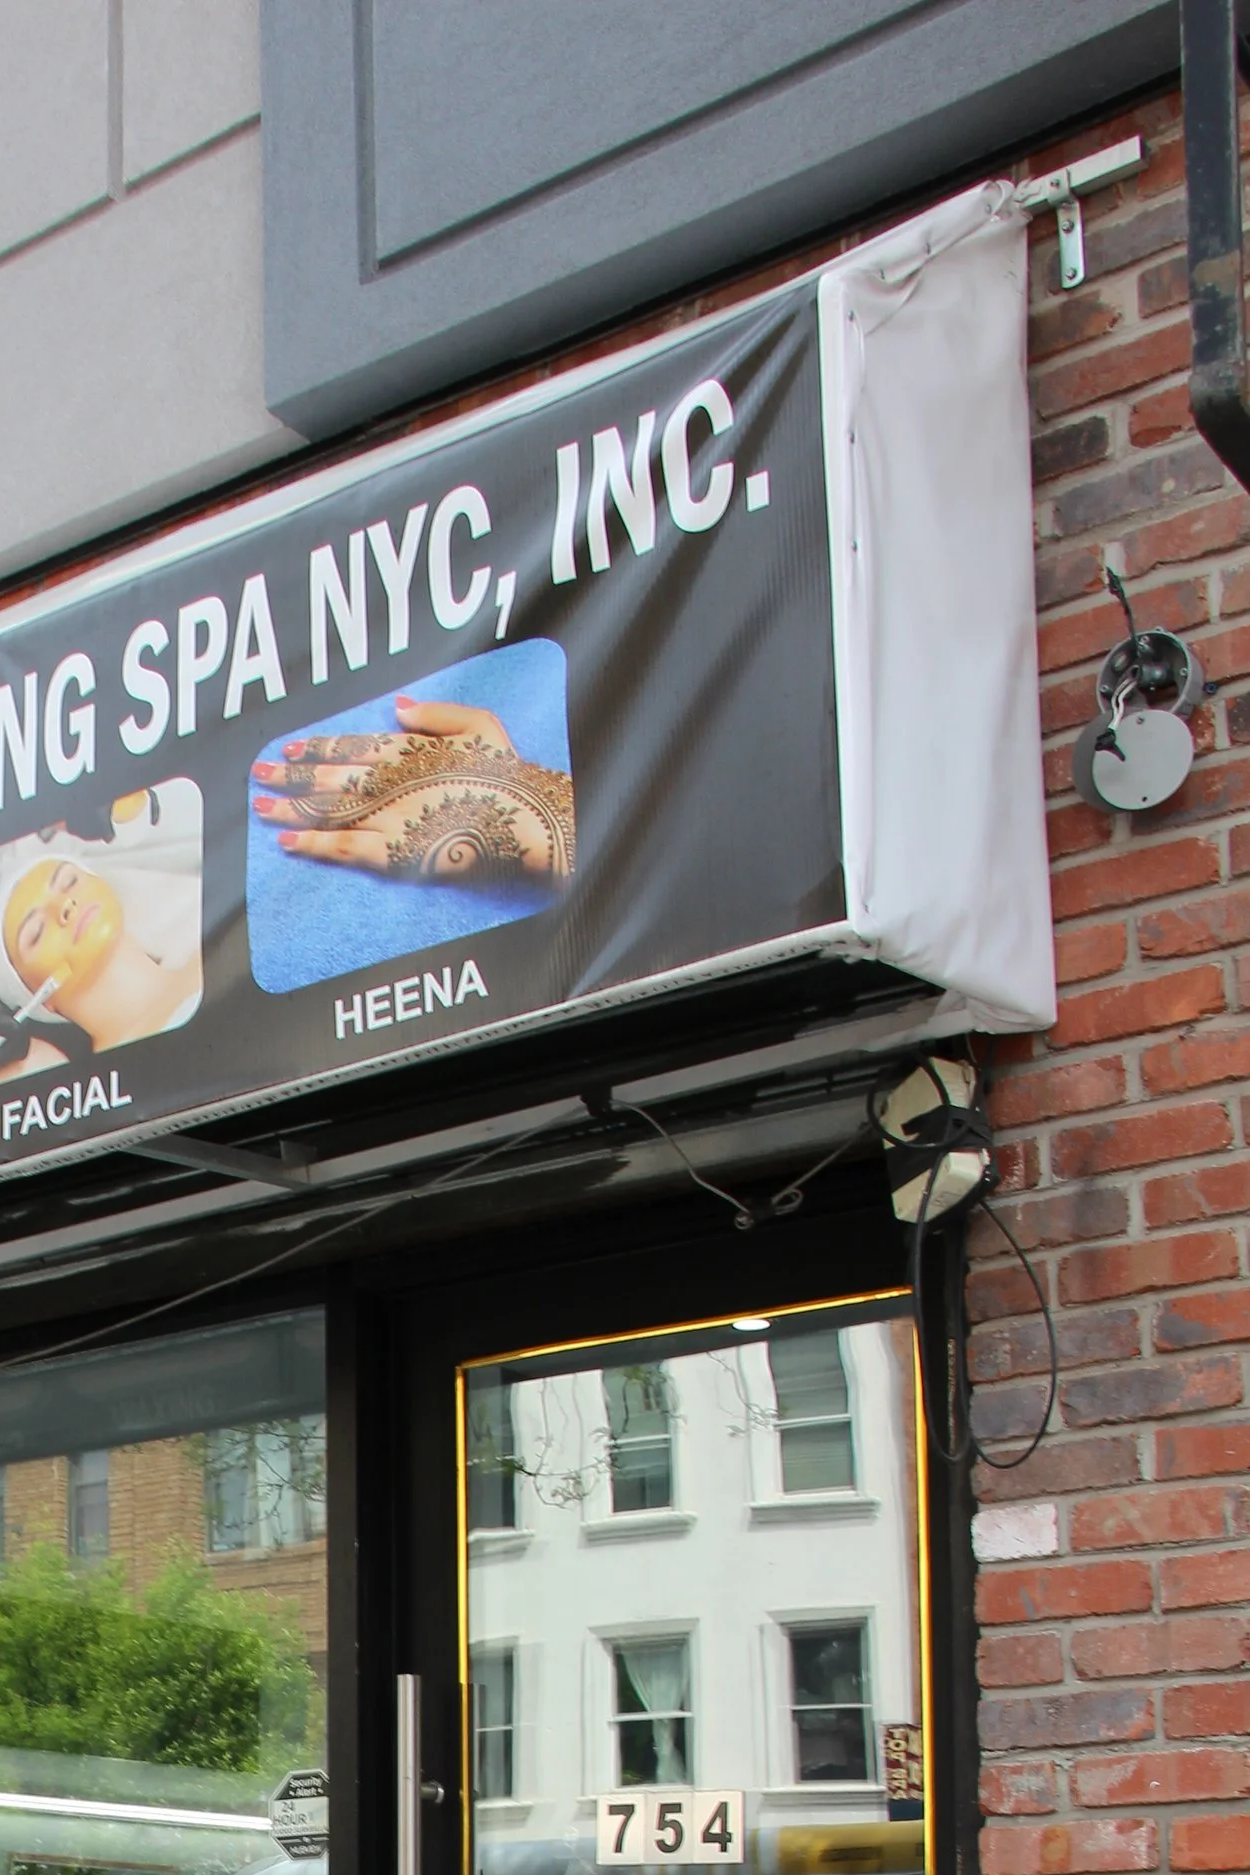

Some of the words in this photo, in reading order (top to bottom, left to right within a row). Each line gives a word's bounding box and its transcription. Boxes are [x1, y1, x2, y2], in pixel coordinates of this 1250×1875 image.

[119, 573, 286, 756] SPA
[308, 485, 519, 685] NYC,
[551, 378, 770, 585] INC.
[334, 958, 489, 1040] HEENA
[1, 1071, 132, 1142] FACIAL
[607, 1801, 733, 1855] 754
